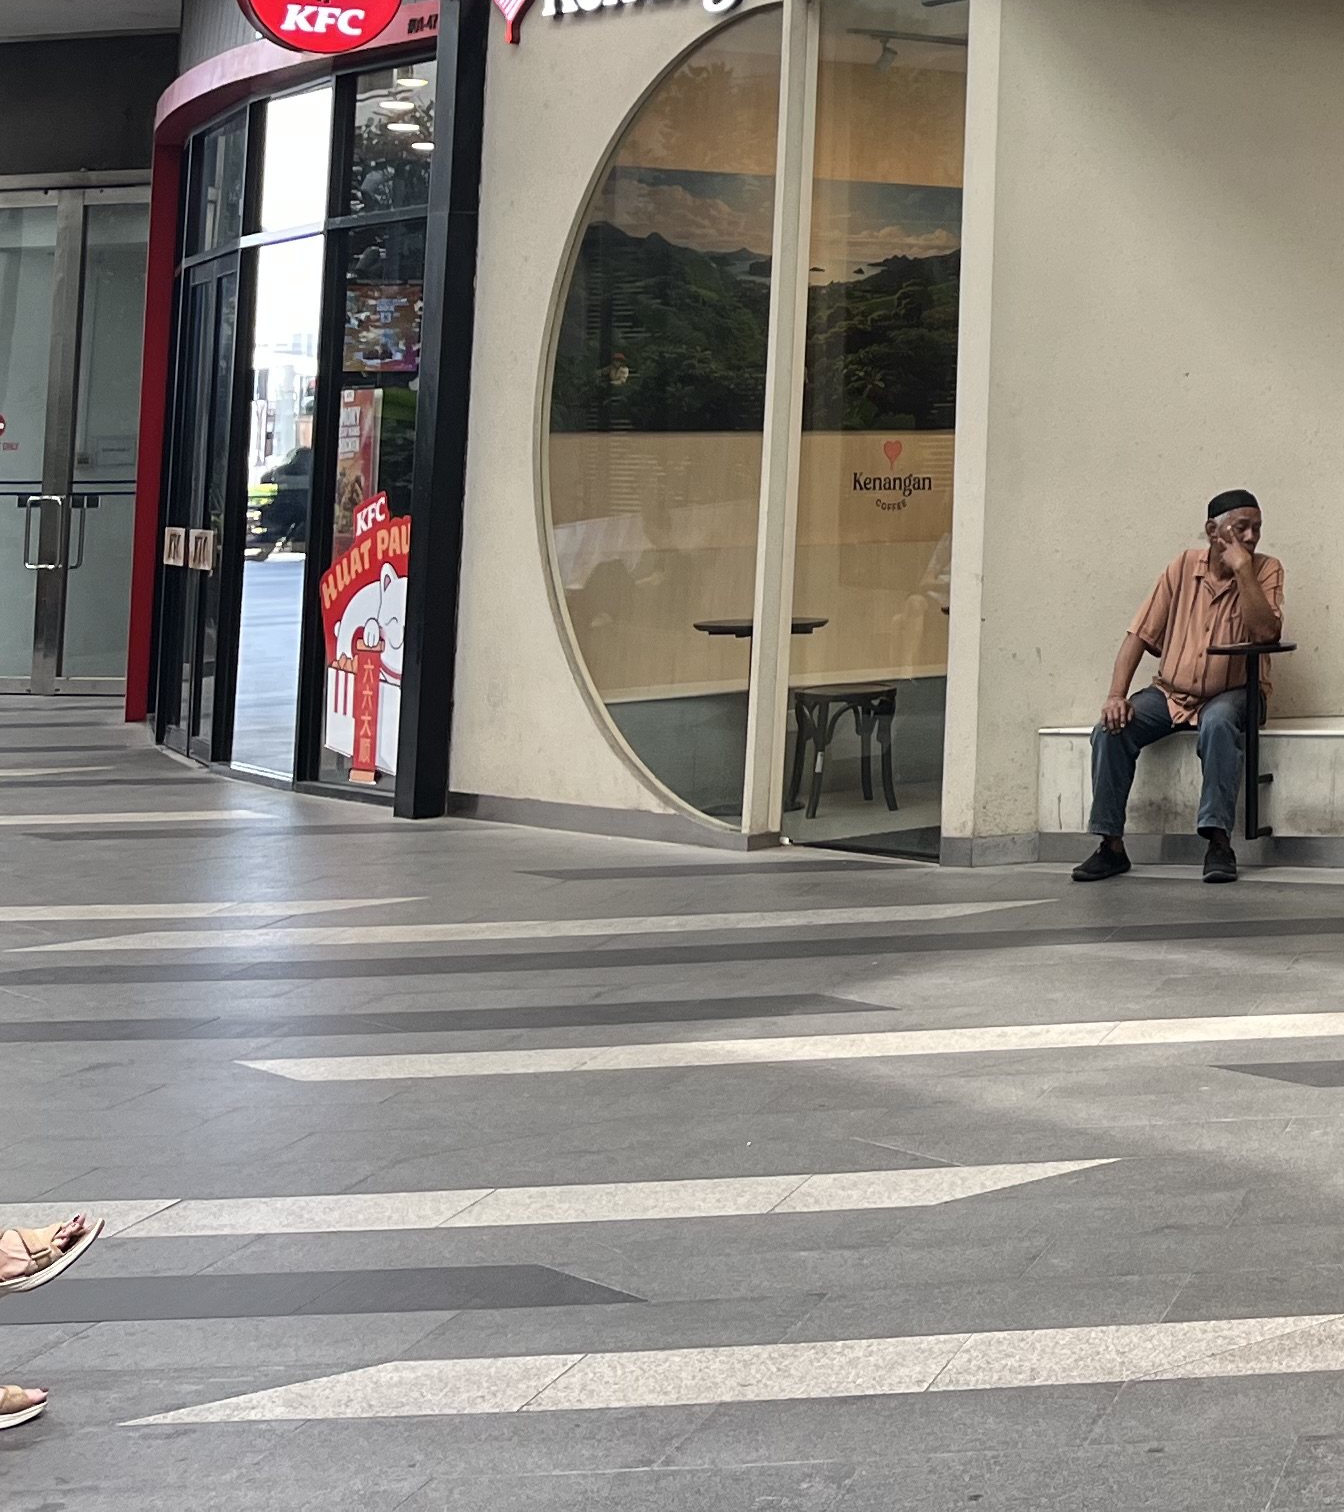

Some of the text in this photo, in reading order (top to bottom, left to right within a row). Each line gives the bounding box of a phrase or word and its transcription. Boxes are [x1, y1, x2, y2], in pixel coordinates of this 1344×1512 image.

[280, 3, 366, 36] KFC
[852, 472, 932, 497] Kenangan
[355, 496, 386, 537] KFC
[875, 498, 908, 511] COFFEE
[321, 522, 411, 610] HUAT PAU
